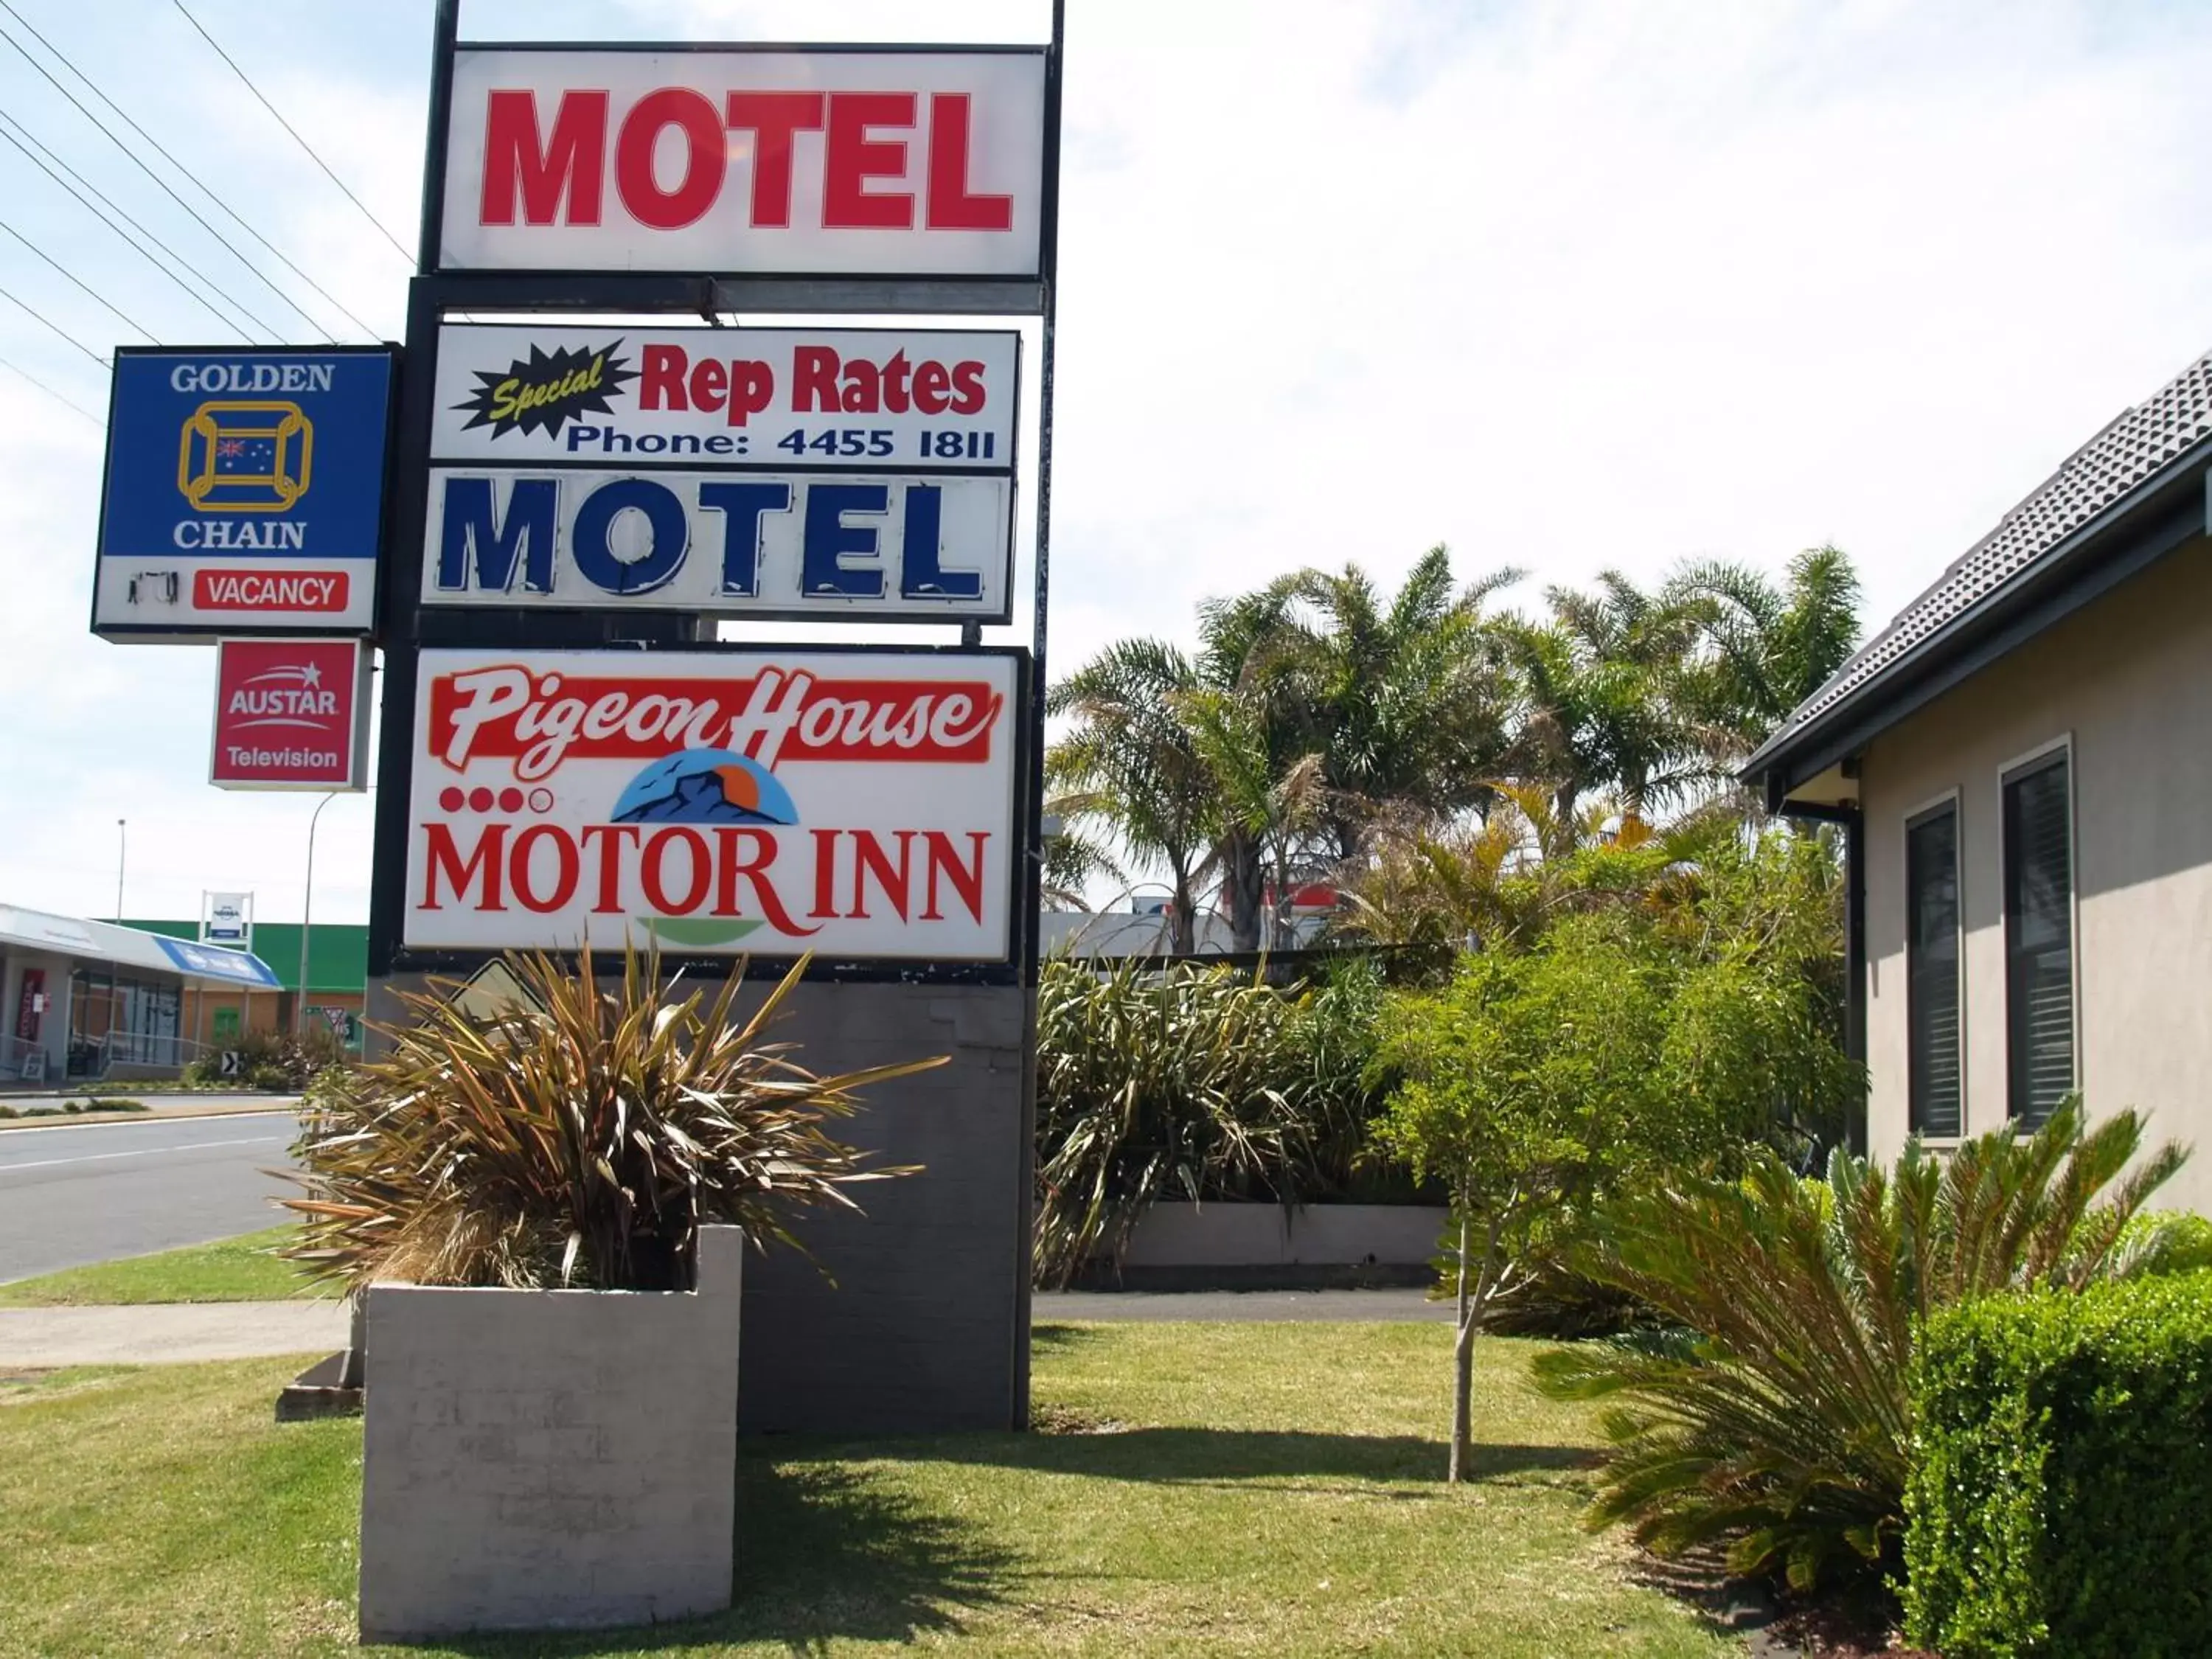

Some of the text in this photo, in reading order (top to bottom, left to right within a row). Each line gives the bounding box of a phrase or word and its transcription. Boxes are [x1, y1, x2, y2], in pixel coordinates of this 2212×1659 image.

[479, 87, 1013, 232] MOTEL
[170, 364, 335, 392] GOLDEN
[489, 354, 603, 421] Special
[639, 344, 986, 427] Rep Rates
[566, 425, 995, 459] Phone: 4455 1811
[173, 521, 307, 549] CHAIN
[437, 476, 983, 600] MOTEL
[207, 577, 335, 605] VACANCY
[229, 689, 336, 714] AUSTAR
[444, 665, 1002, 782] Pigeon House
[226, 746, 338, 768] Television
[417, 823, 991, 937] MOTOR INN
